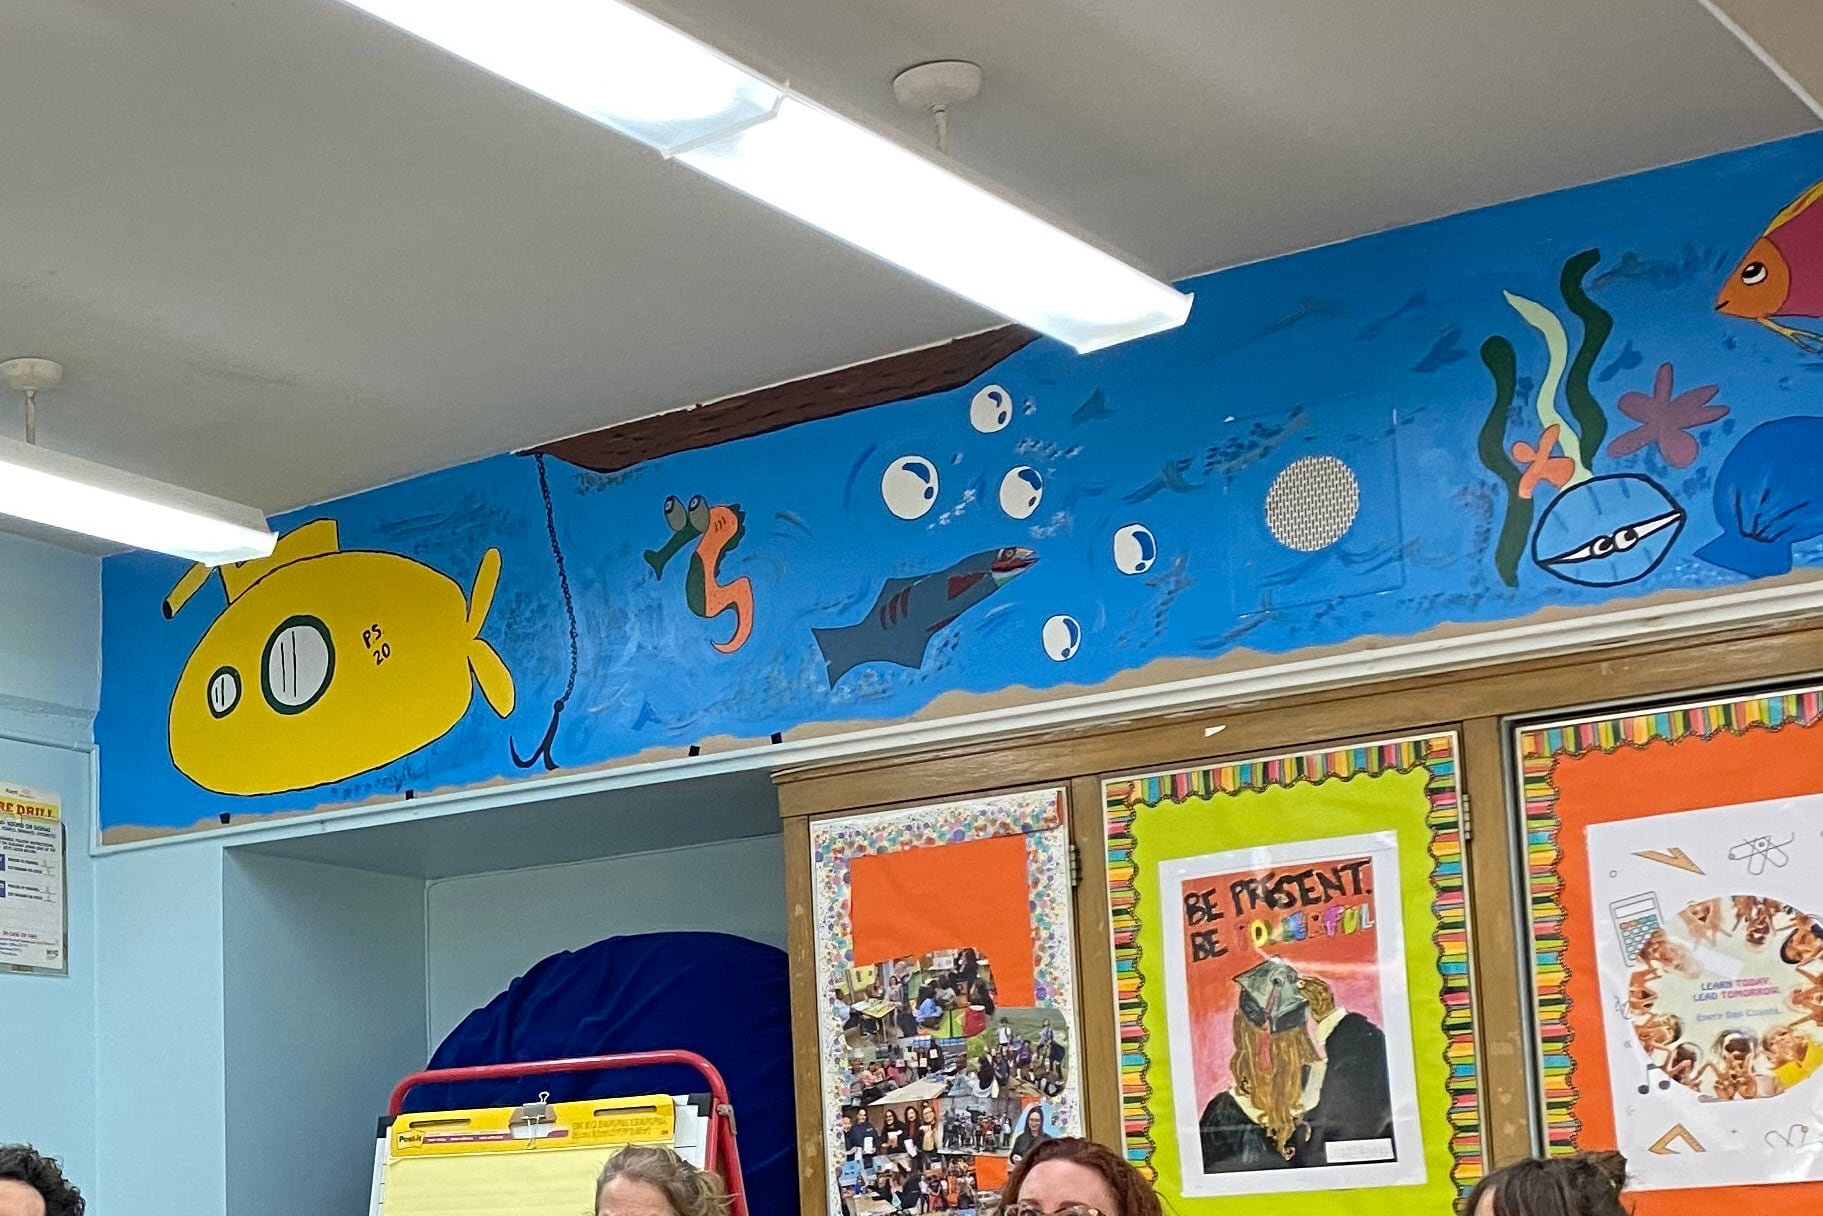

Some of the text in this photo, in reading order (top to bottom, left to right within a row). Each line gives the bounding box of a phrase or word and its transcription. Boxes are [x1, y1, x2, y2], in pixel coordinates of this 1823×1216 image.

[373, 642, 391, 666] 20
[16, 804, 56, 818] DRILL
[1184, 888, 1225, 926] BE
[1190, 928, 1229, 963] BE
[1701, 981, 1733, 991] LEARN
[1693, 992, 1718, 1002] LEAD
